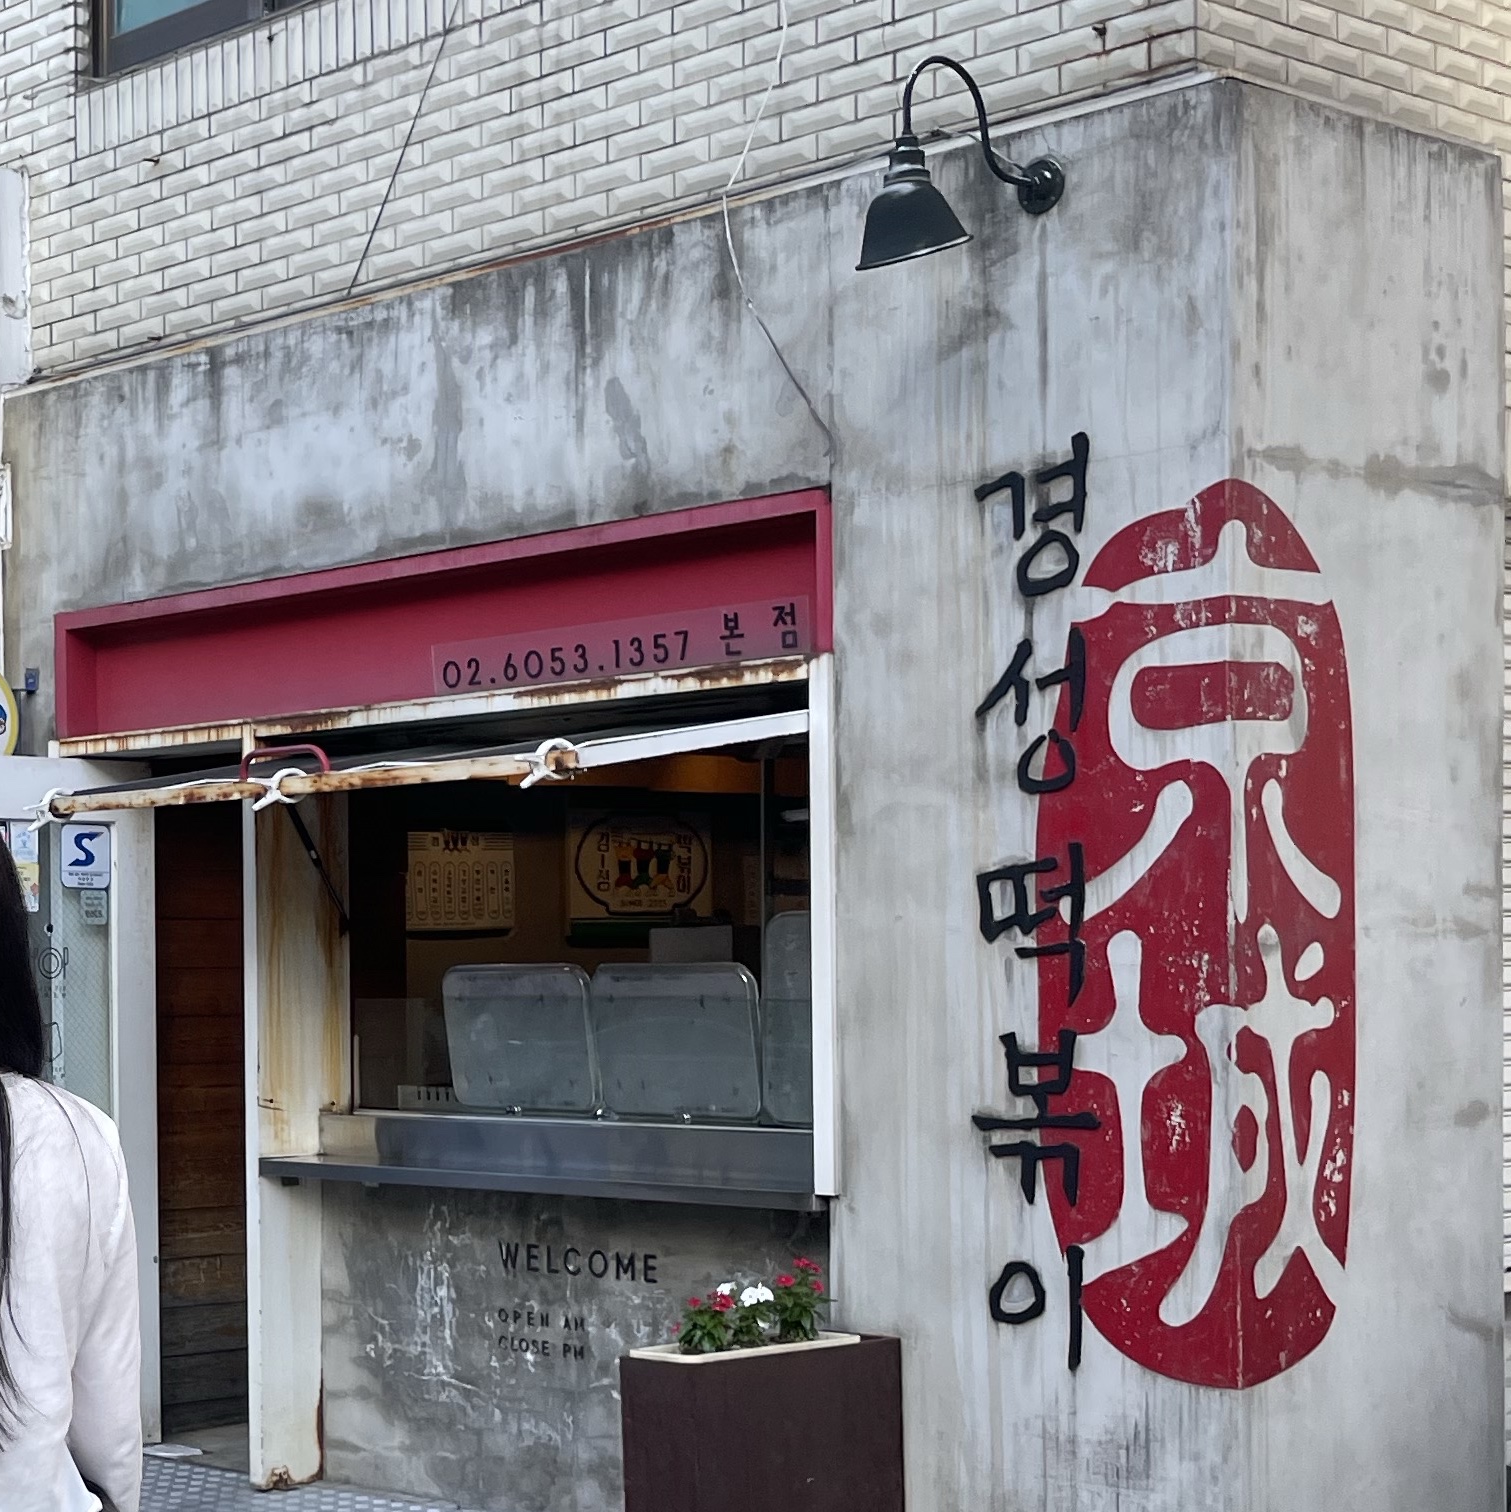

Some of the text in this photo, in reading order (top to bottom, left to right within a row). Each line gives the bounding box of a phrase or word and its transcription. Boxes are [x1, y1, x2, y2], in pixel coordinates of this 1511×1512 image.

[442, 630, 690, 689] 02.6053.1357
[498, 1240, 658, 1283] WELCOME
[498, 1308, 549, 1328] OPEN
[498, 1335, 584, 1360] CLOSE PM
